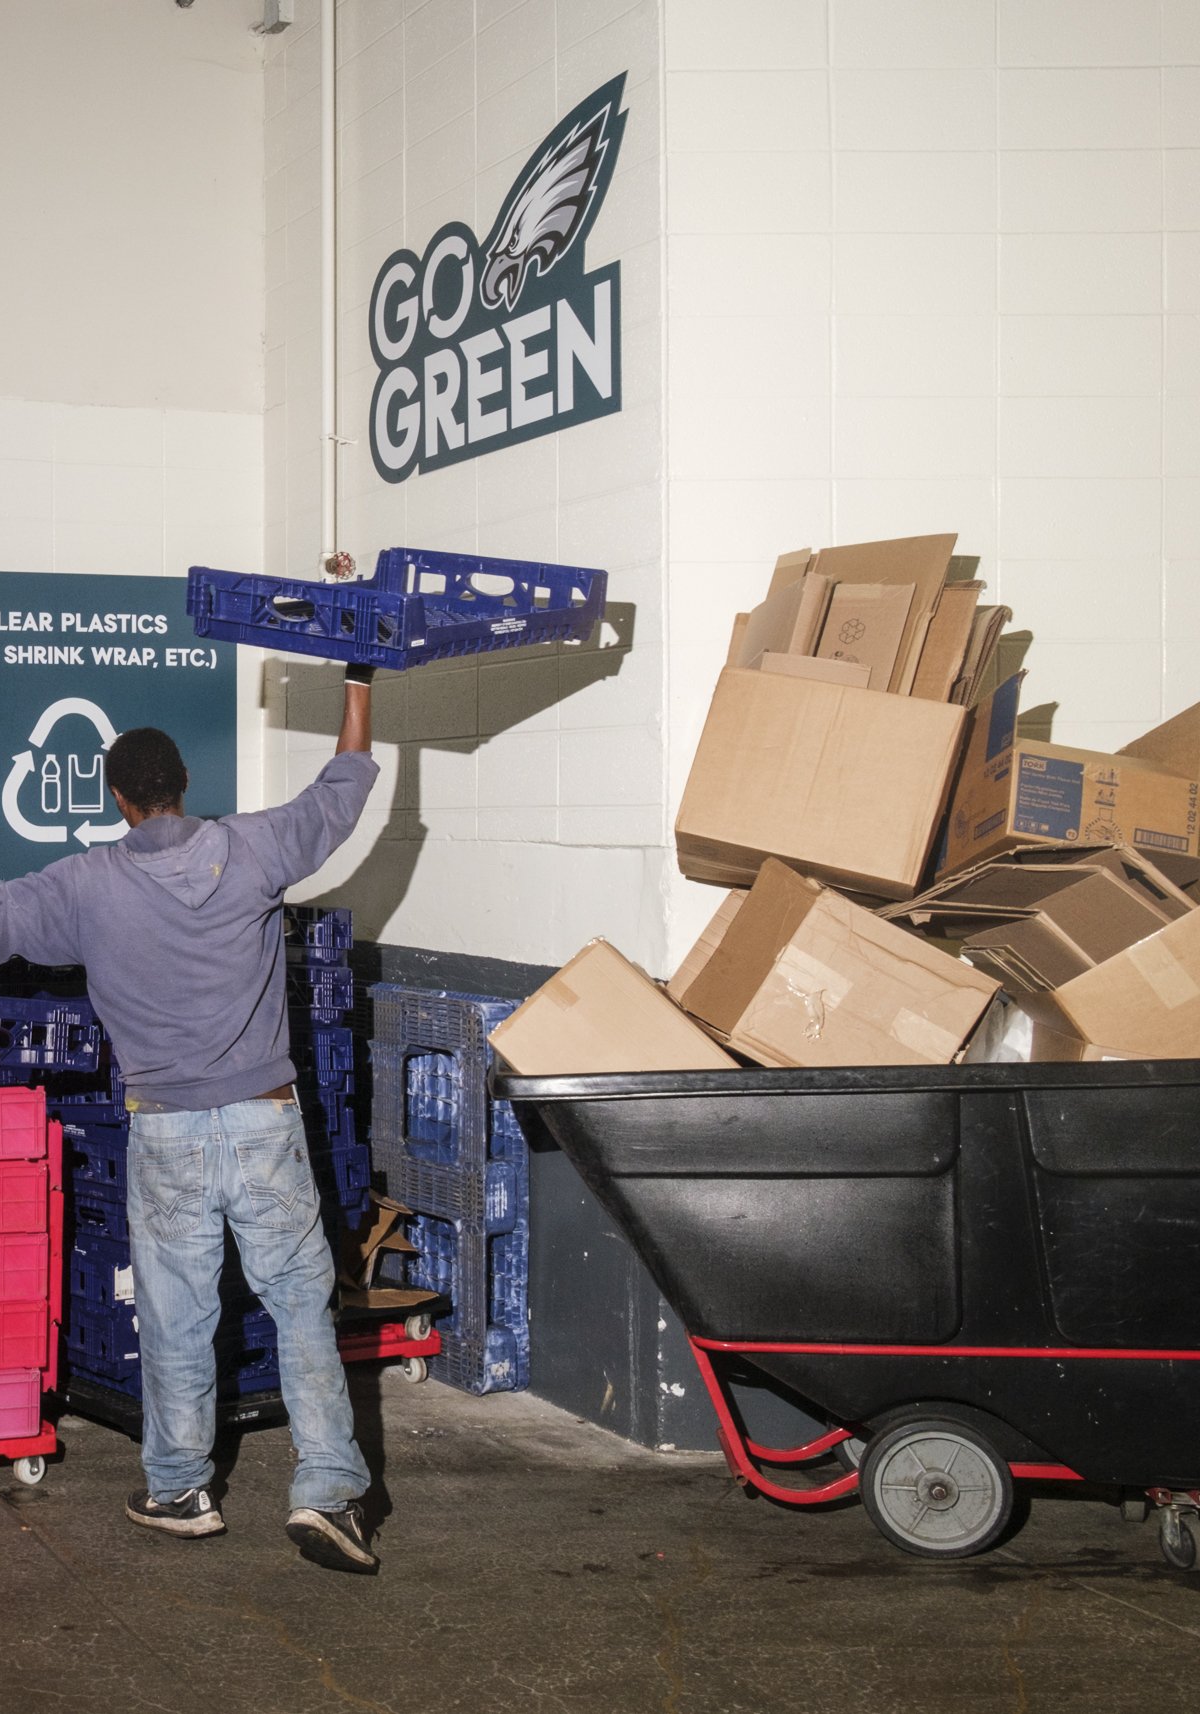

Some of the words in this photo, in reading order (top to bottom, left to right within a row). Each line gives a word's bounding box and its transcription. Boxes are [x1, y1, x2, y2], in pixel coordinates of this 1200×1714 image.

[375, 236, 474, 361] GO
[375, 279, 612, 470] GREEN
[4, 645, 85, 665] SHRINK
[91, 647, 159, 669] WRAP,
[165, 648, 217, 669] ETC.)
[61, 612, 168, 635] PLASTICS
